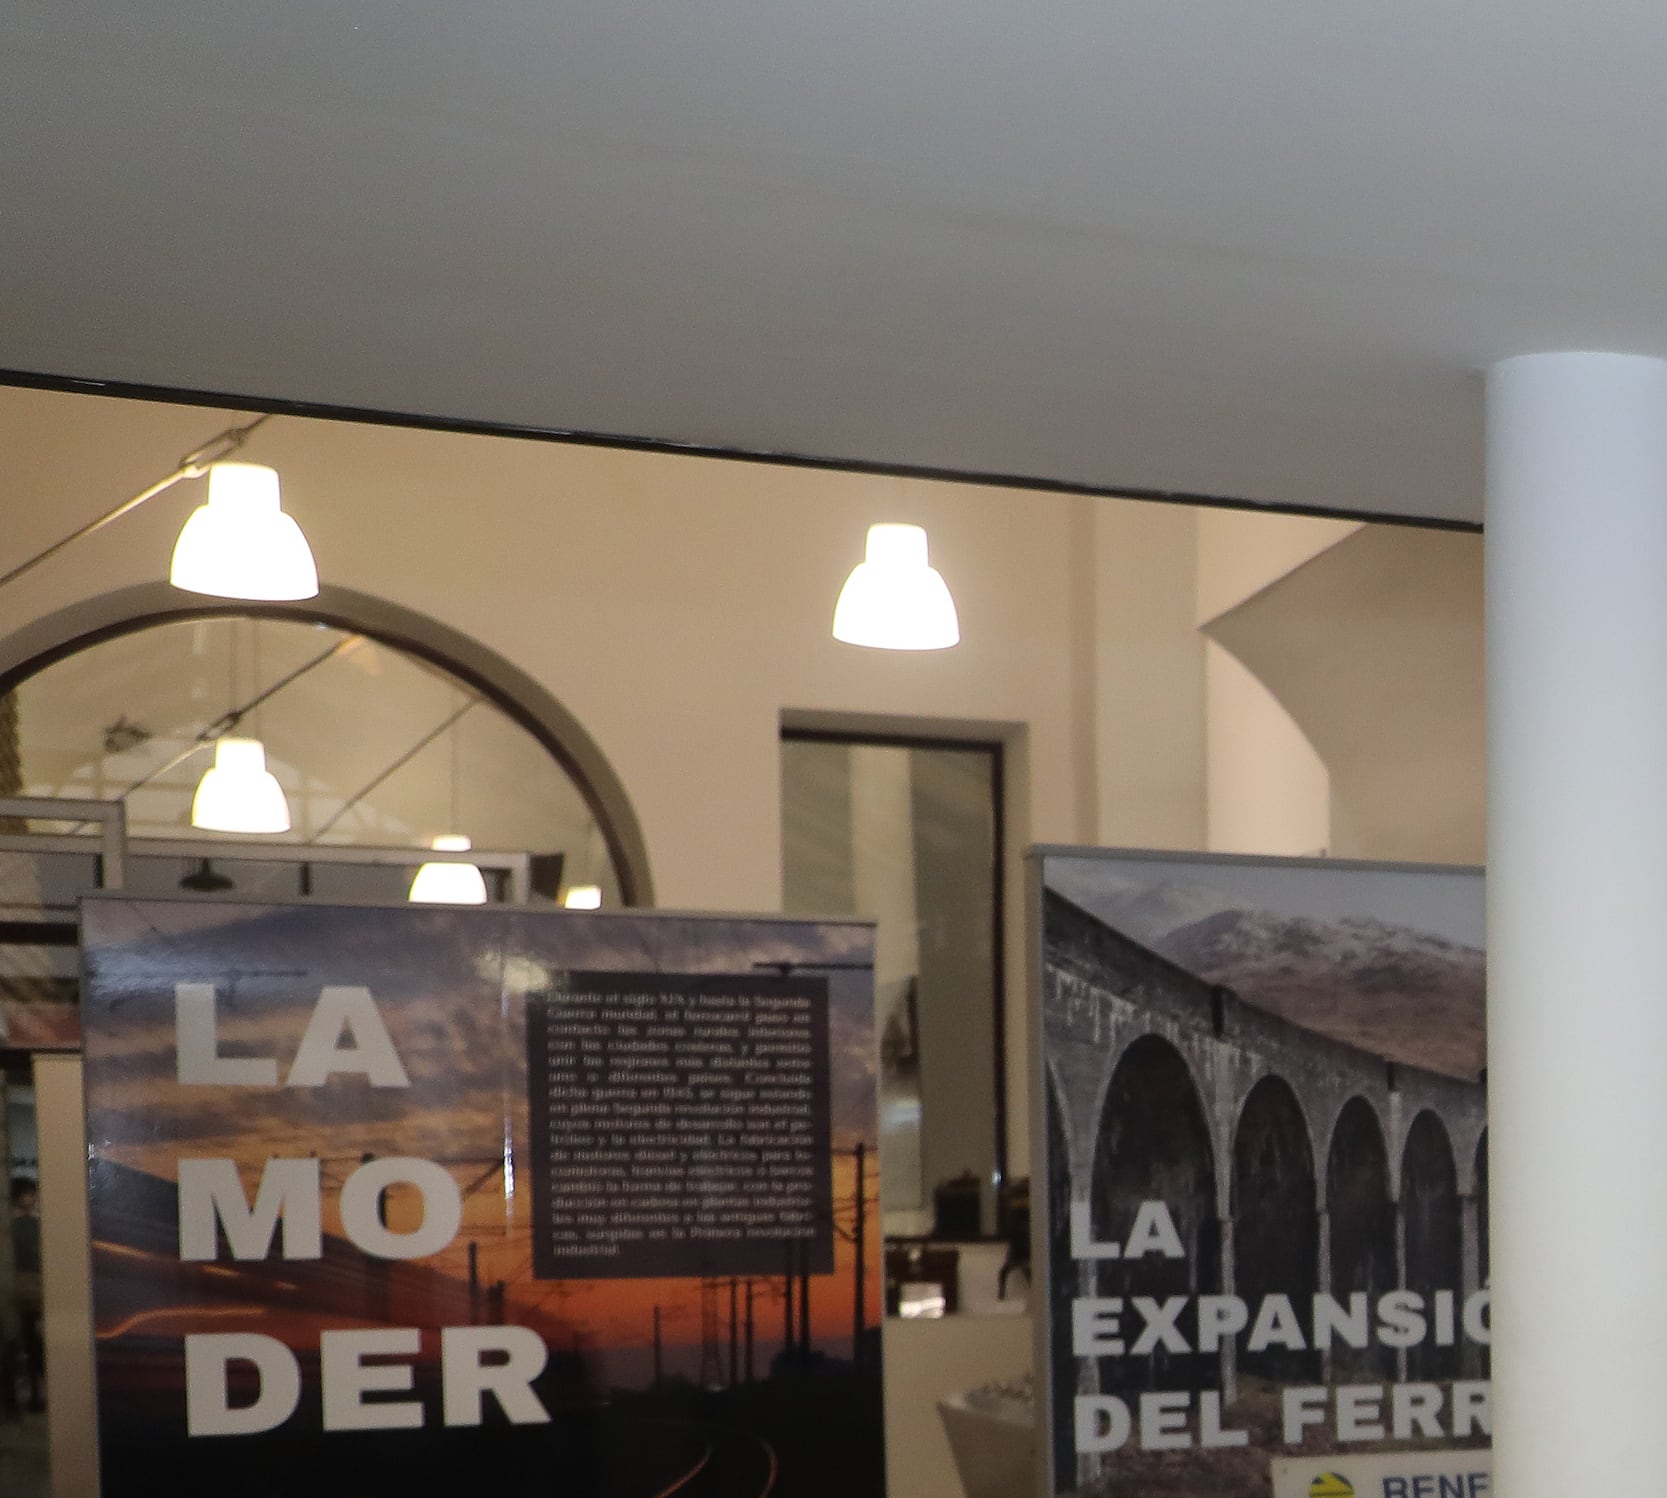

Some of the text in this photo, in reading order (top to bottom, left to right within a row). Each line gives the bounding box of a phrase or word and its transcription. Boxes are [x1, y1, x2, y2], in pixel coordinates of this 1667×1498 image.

[175, 983, 410, 1088] LA
[178, 1157, 462, 1261] MO
[1070, 1200, 1185, 1260] LA
[185, 1325, 552, 1438] DER
[1074, 1390, 1249, 1454] DEL
